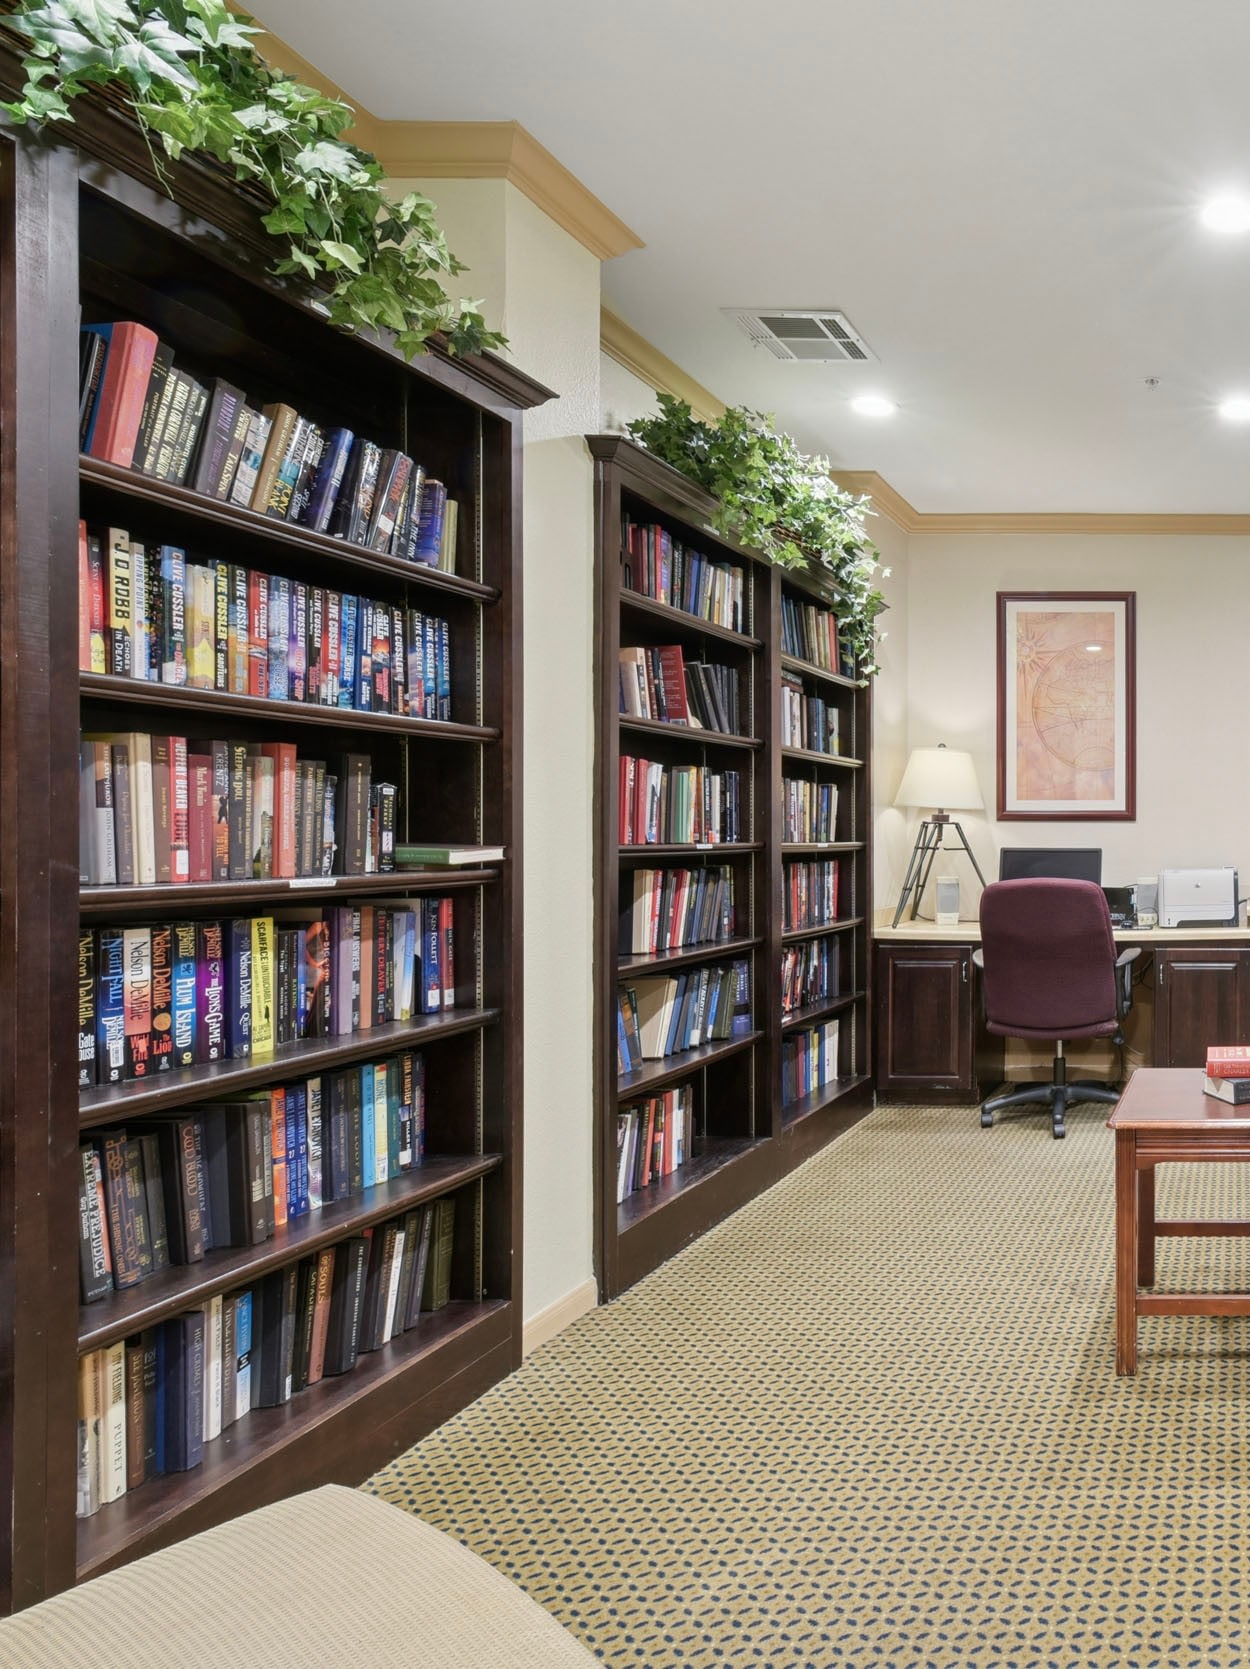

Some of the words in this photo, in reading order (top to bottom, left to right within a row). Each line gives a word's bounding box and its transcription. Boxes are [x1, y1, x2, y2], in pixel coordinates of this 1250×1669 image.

[172, 553, 184, 580] CLIVE
[216, 564, 228, 593] CLIVE
[236, 570, 246, 597] CLIVE
[114, 576, 130, 619] ROBB
[172, 584, 184, 630] CUSSLER
[260, 578, 268, 602] CLIVE
[279, 581, 290, 608] CLIVE
[297, 586, 306, 610] CLIVE
[328, 594, 338, 619] CLIVE
[217, 595, 228, 640] CUSSLER
[236, 599, 247, 643] CUSSLER
[260, 604, 268, 640] CUSSLER
[280, 610, 290, 652] CUSSLER
[298, 612, 306, 648] CUSSLER
[376, 608, 384, 640] CUSSLER
[394, 611, 402, 634] CLIVE
[426, 619, 434, 640] CLIVE
[115, 630, 123, 641] IN
[328, 620, 338, 664] CUSSLER
[114, 642, 124, 672] DEATH
[394, 636, 403, 673] CUSSLER
[416, 638, 424, 672] CUSSLER
[426, 643, 435, 679] CUSSLER
[442, 646, 450, 680] CUSSLER
[176, 743, 188, 776] JEFFERY
[216, 753, 224, 786] KRENTZ
[176, 779, 188, 809] DEAVER
[152, 930, 172, 966] Nelson
[257, 921, 268, 961] SCARFACE
[430, 932, 438, 964] FOLLETT
[130, 942, 150, 976] Nelson
[240, 950, 250, 978] Nelson
[130, 980, 150, 1020] DeMille
[152, 968, 172, 1010] DeMille
[176, 977, 196, 1006] PLUM
[240, 979, 251, 1009] DeMille
[176, 1008, 196, 1048] ISLAND
[204, 1013, 222, 1046] GAME
[312, 1089, 321, 1113] JANET
[312, 1115, 322, 1162] EVANOVICH
[84, 1150, 100, 1208] EXTREME
[90, 1211, 106, 1279] PREJUDICE
[114, 1423, 122, 1472] PUPPET
